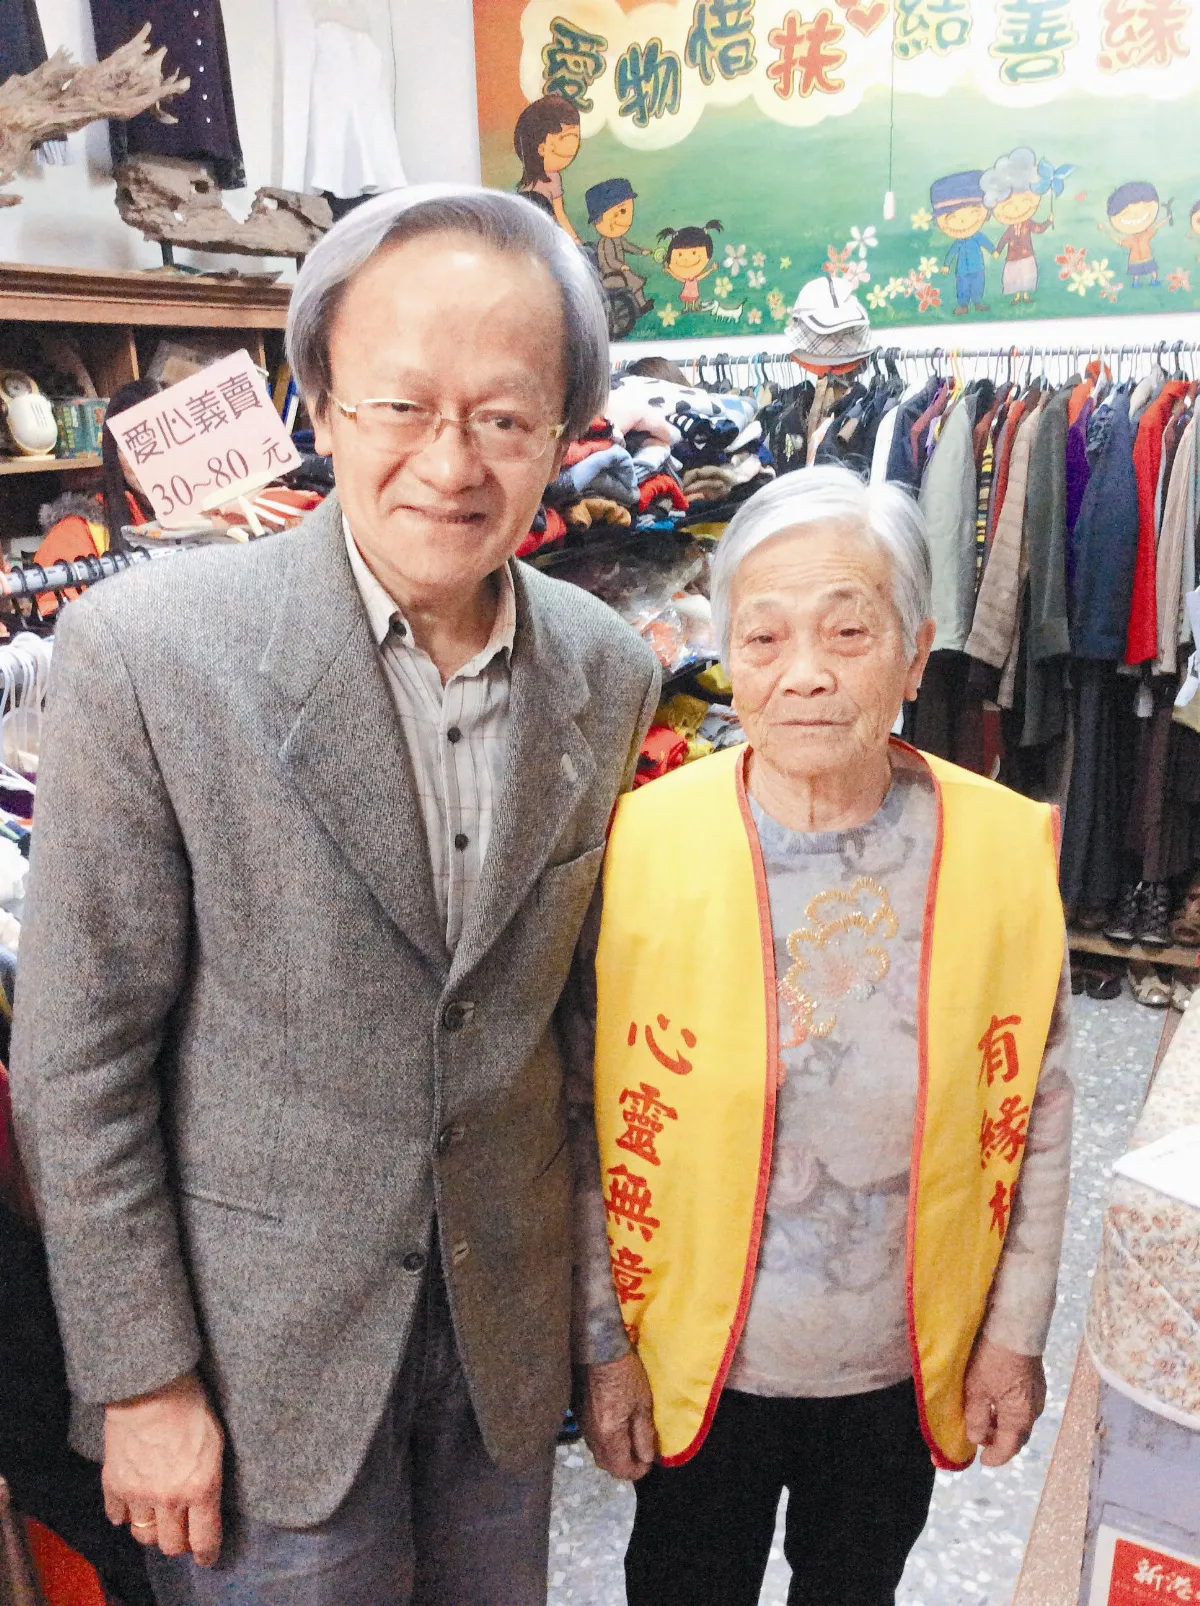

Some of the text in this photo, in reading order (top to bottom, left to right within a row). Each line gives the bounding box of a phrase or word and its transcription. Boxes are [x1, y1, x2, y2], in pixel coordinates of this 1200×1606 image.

[121, 371, 264, 466] 愛心義賣
[151, 437, 293, 517] 30~80 元
[604, 1013, 697, 1347] 心靈無障
